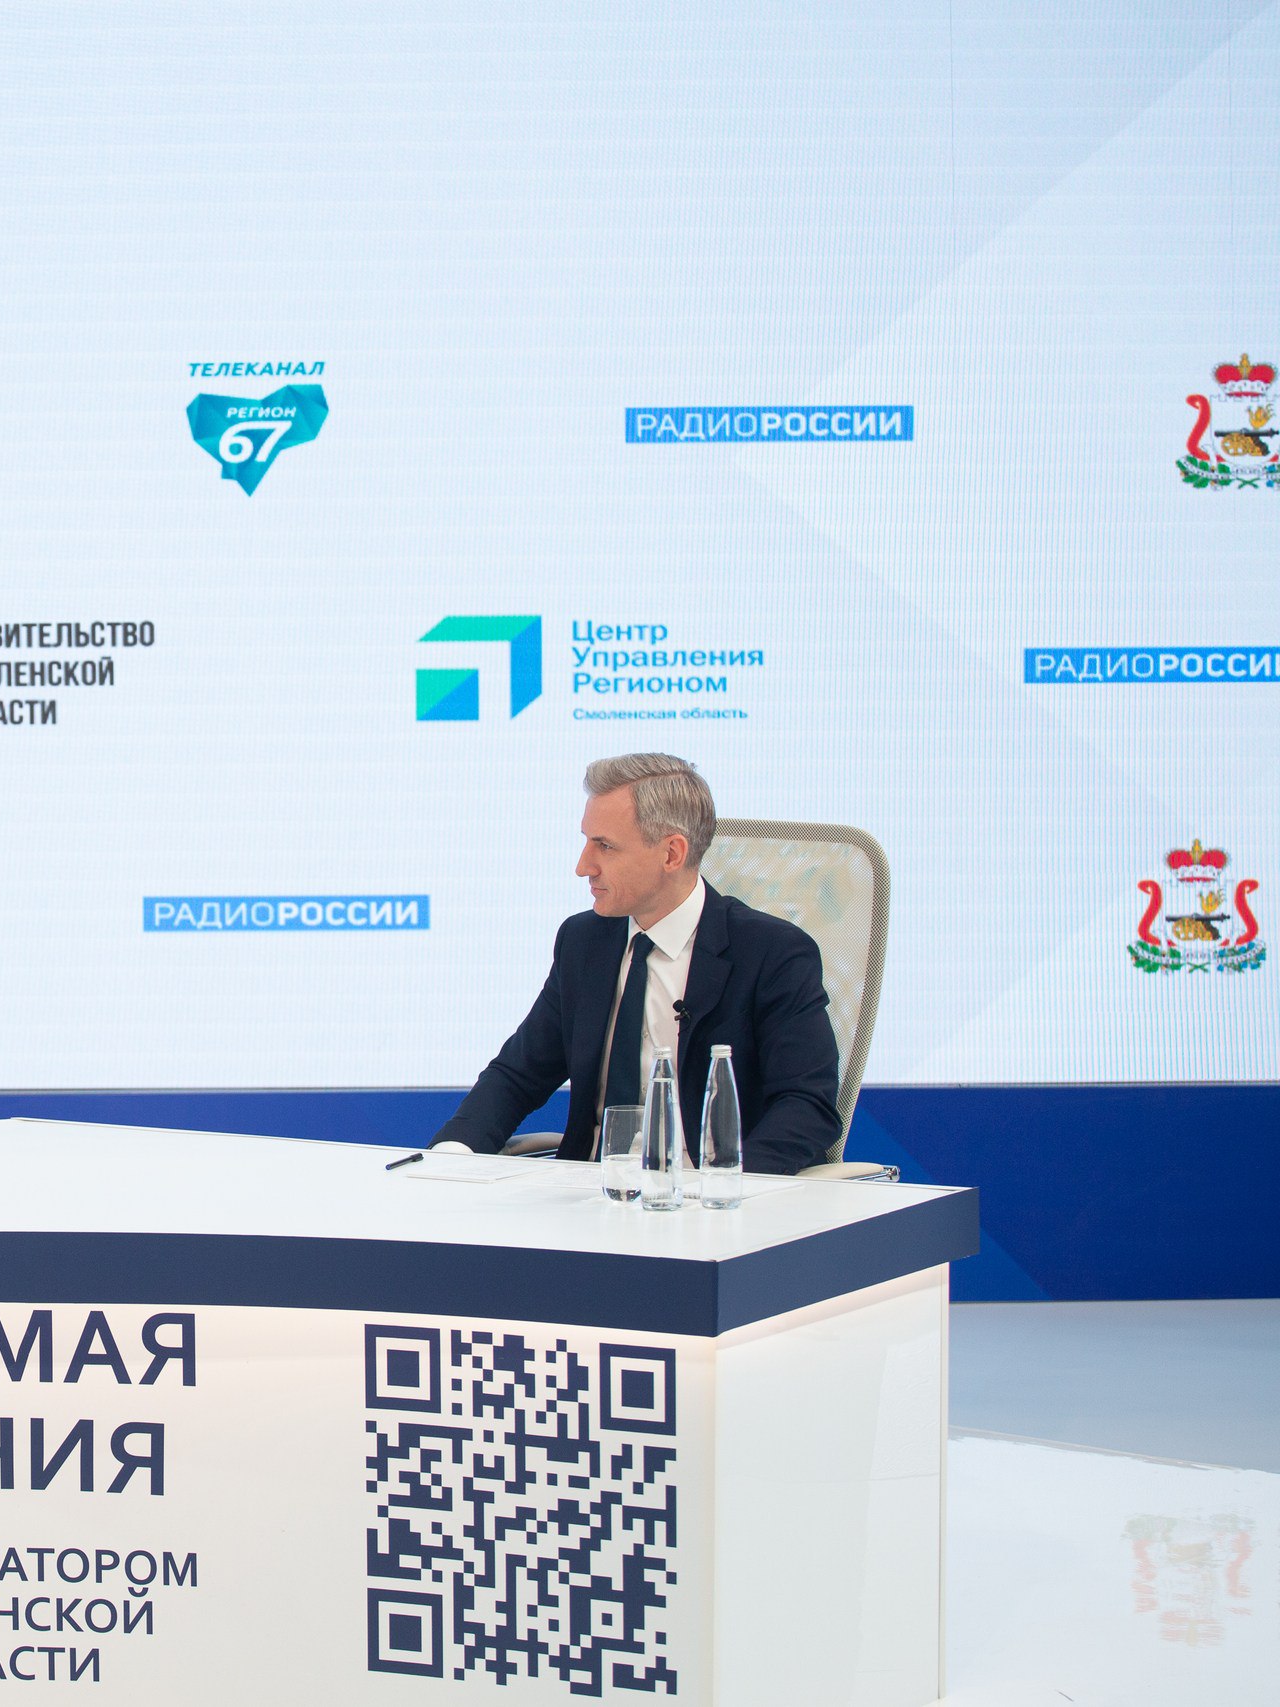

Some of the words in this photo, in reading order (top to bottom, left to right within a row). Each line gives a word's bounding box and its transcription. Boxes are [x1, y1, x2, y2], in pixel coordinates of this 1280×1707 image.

[189, 362, 325, 377] ТЕЛЕКАНАЛ
[227, 406, 297, 418] РЕГИОН
[219, 420, 292, 464] 67
[572, 620, 668, 645] Центр
[572, 646, 764, 672] Управления
[1035, 653, 1280, 682] РАДИОРОССИ
[573, 673, 727, 693] Регионом
[573, 708, 676, 720] Смоленская
[680, 707, 748, 719] область
